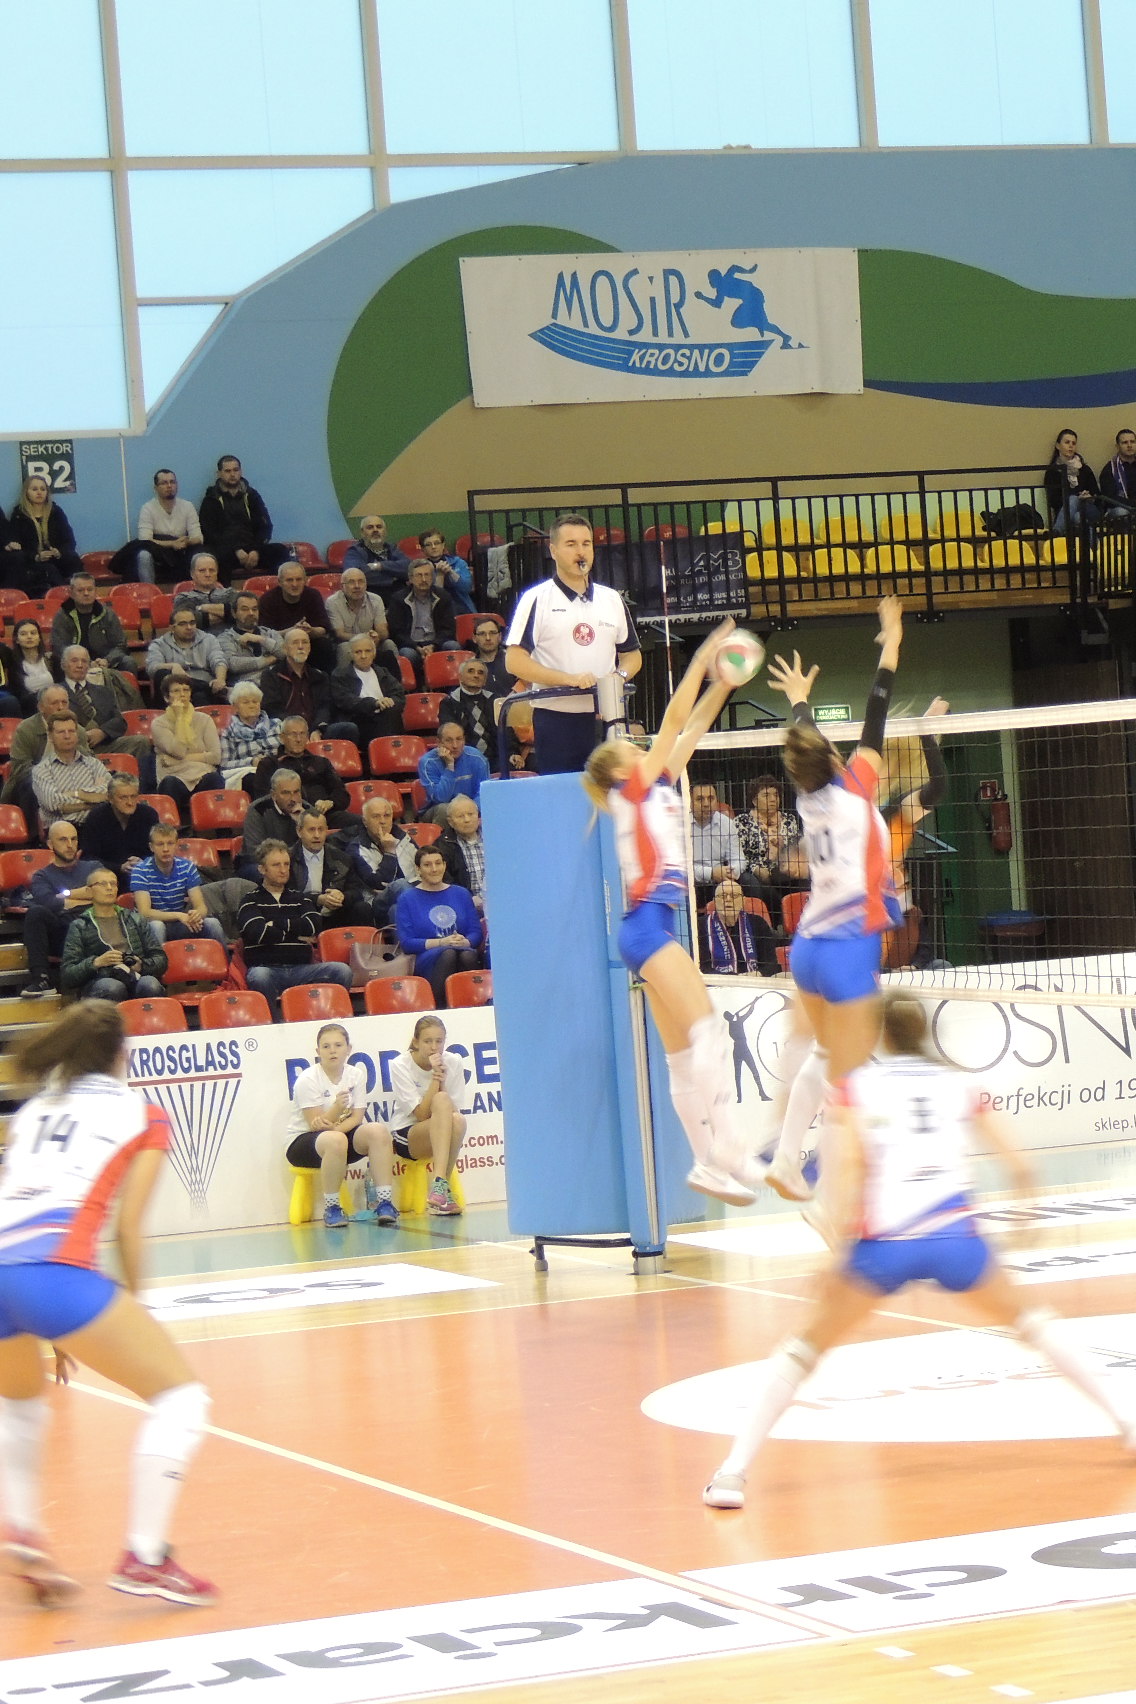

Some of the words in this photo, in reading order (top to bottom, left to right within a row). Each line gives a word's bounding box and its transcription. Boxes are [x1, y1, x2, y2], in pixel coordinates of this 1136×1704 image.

[551, 267, 690, 339] MOSiR
[628, 347, 731, 373] KROSNO
[21, 443, 72, 456] SEKTOR
[27, 460, 72, 488] B2
[127, 1039, 241, 1079] KROSGLASS
[979, 1083, 1072, 1116] Perfekcji
[1079, 1079, 1106, 1104] od
